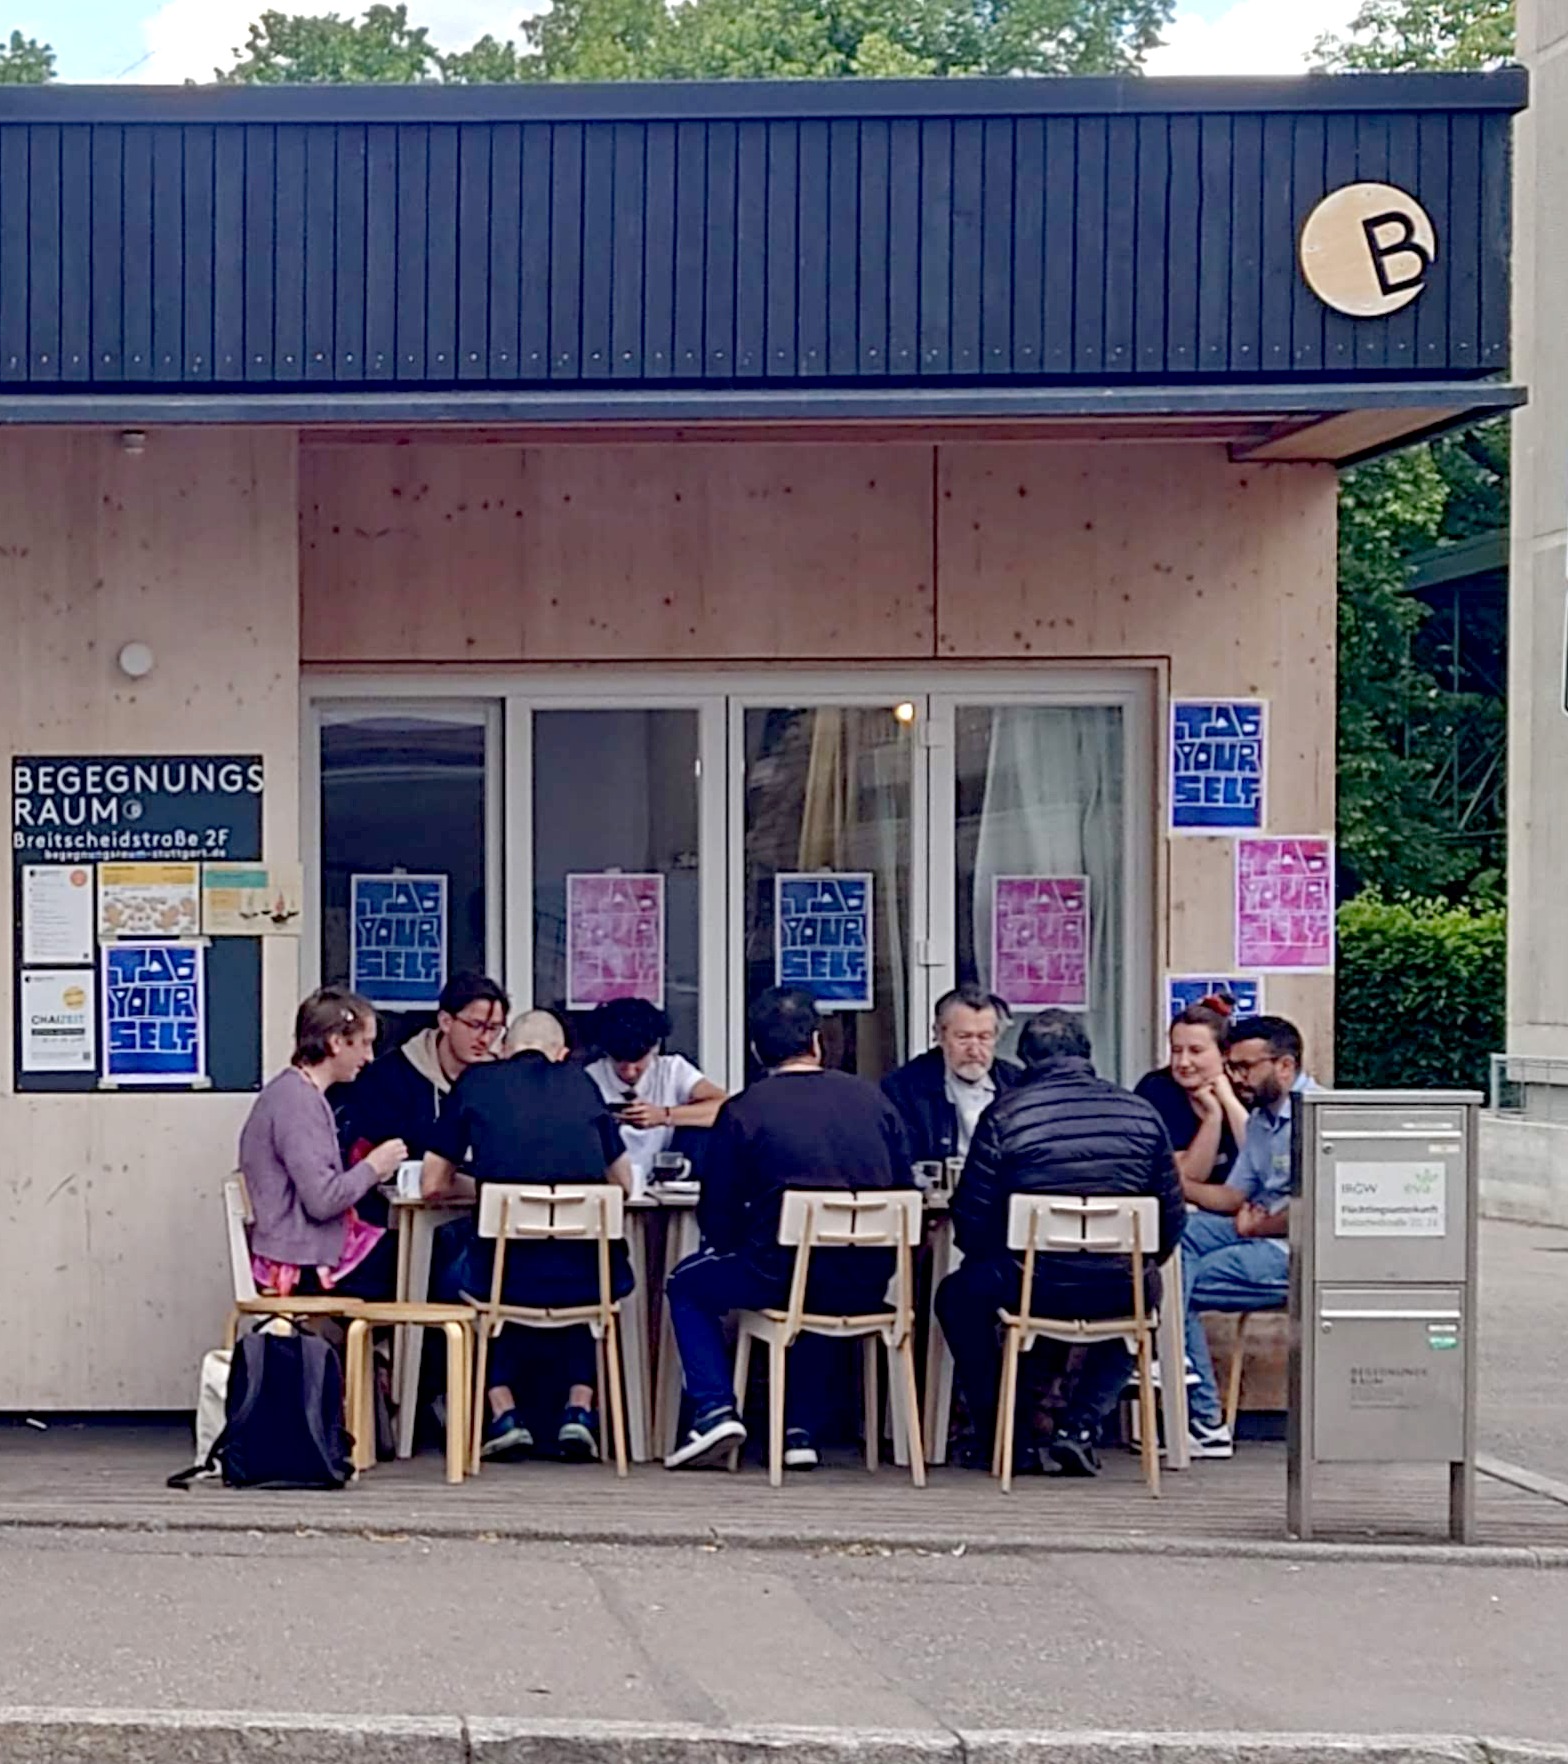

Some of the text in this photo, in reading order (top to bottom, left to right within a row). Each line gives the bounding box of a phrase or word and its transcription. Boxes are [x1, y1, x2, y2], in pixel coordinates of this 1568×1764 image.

[1363, 211, 1431, 297] B
[1176, 742, 1261, 774] YOUR
[14, 763, 264, 795] BEGEGNUNGS
[1176, 775, 1261, 807] SELF
[14, 796, 118, 826] RAUM
[13, 829, 230, 849] Breitscheidstraße 2F
[357, 917, 441, 949] YOUR
[782, 916, 867, 949] YOUR
[109, 986, 198, 1018] YOUR
[109, 1020, 198, 1053] SELF
